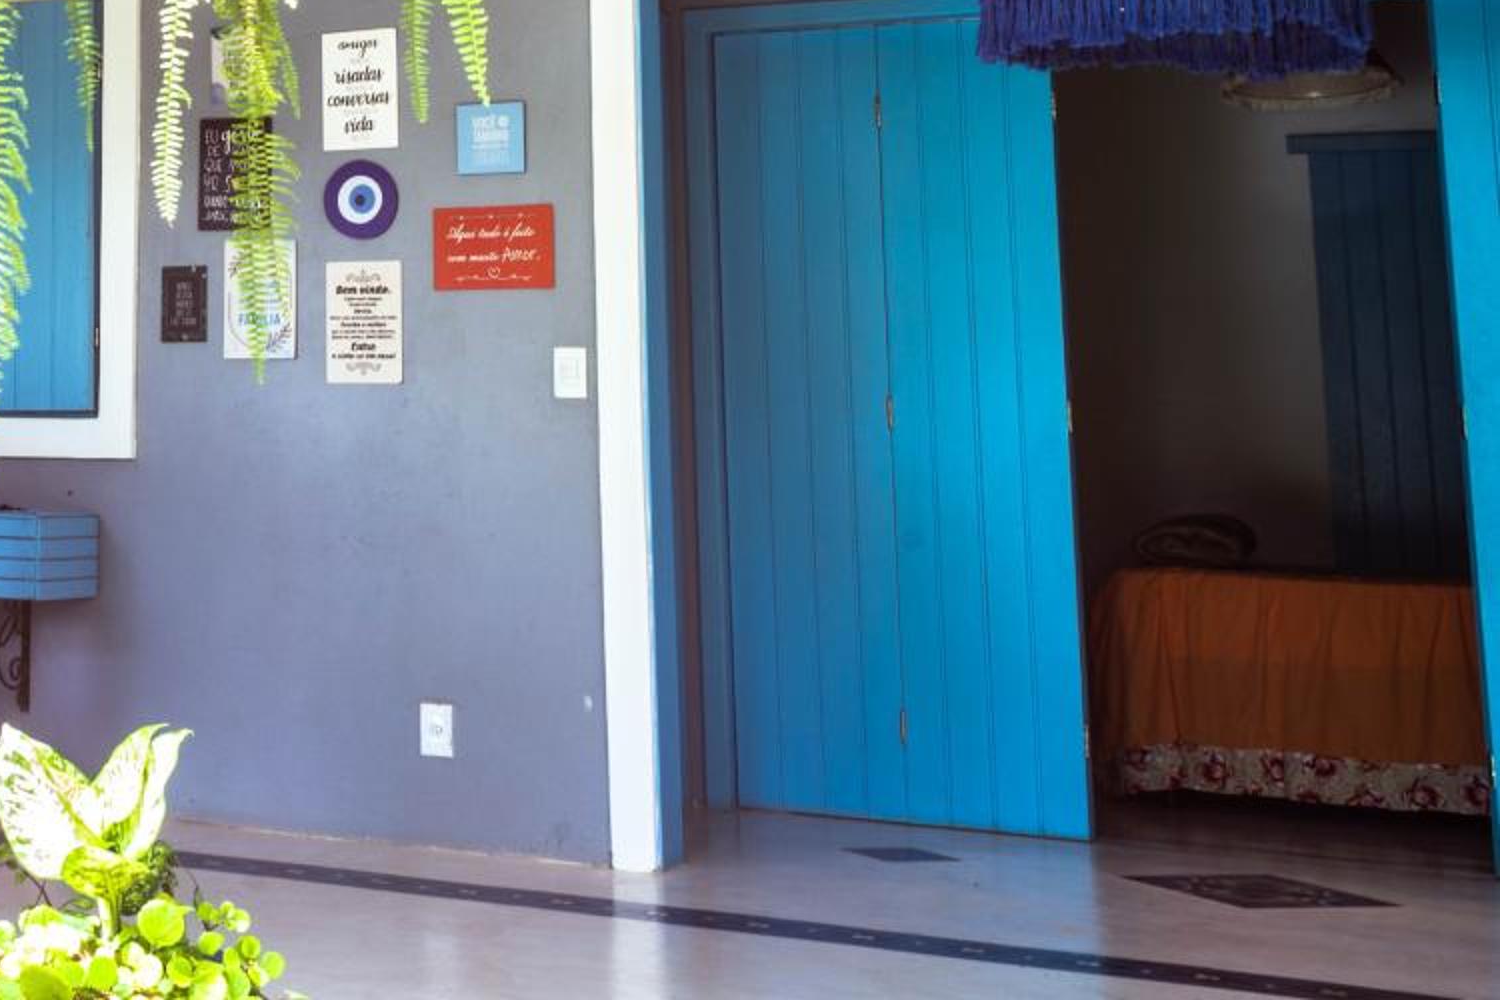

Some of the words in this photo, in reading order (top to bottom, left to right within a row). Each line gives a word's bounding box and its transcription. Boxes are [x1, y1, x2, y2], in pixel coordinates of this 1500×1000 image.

[337, 40, 377, 58] amigos
[334, 66, 382, 84] risadas
[327, 92, 389, 107] conversas
[344, 116, 373, 134] vida
[446, 223, 475, 244] Aqui
[478, 225, 500, 238] tudo
[508, 221, 536, 242] feito
[447, 254, 467, 262] com
[469, 252, 499, 261] muito
[336, 285, 357, 295] Bem
